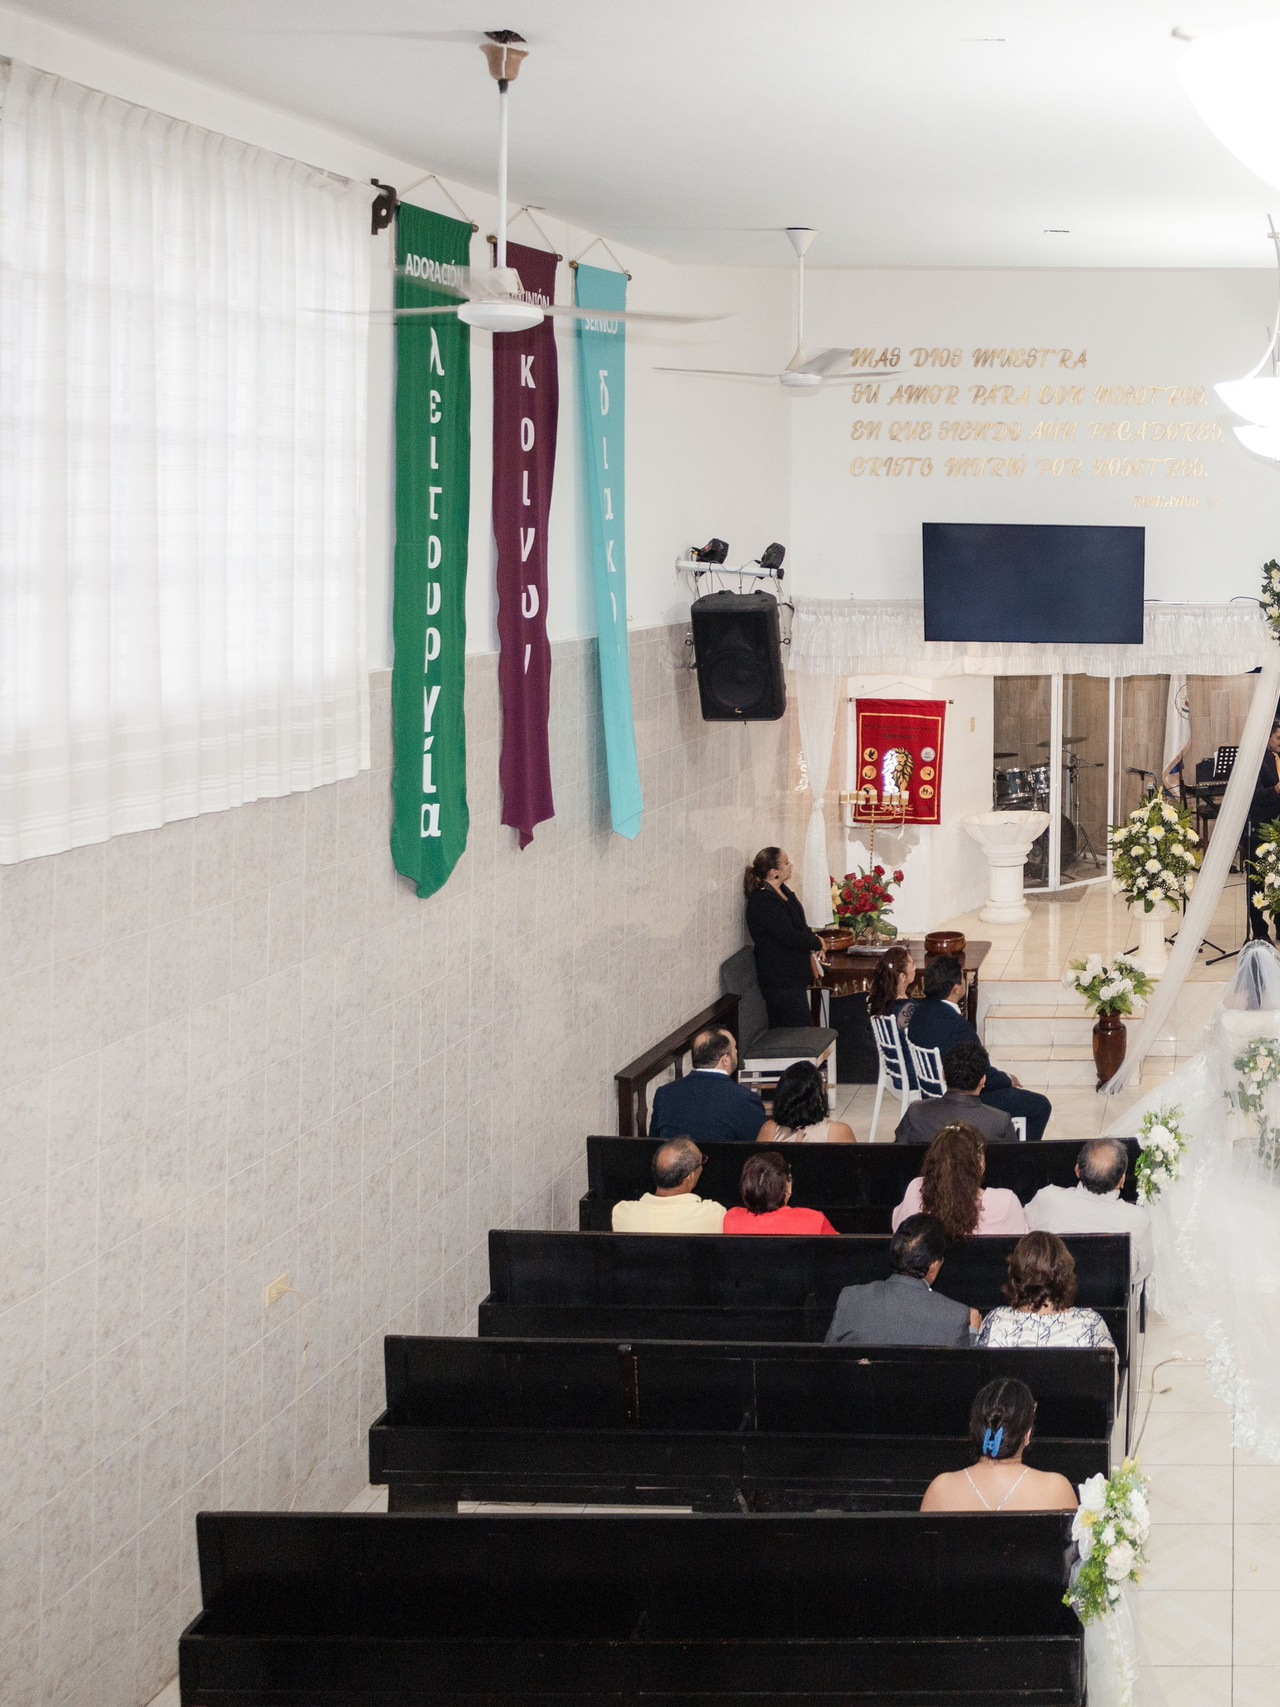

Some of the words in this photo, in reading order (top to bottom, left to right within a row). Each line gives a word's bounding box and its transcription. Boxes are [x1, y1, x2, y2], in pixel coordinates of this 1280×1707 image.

[405, 252, 464, 288] ADORACIÓN
[851, 347, 901, 369] MAS
[909, 347, 964, 369] DIOS
[971, 347, 1088, 370] MUESTRA
[852, 384, 881, 405] SU
[888, 384, 960, 406] AMOR
[968, 385, 1031, 406] PARA
[1038, 386, 1087, 406] CON
[851, 420, 883, 442] EN
[889, 421, 932, 444] QUE
[938, 421, 1022, 442] SIENDO
[850, 456, 934, 478] CRISTO
[944, 453, 1028, 478] MURIÓ
[1035, 458, 1083, 478] POR
[1130, 495, 1200, 509] ROMANOS
